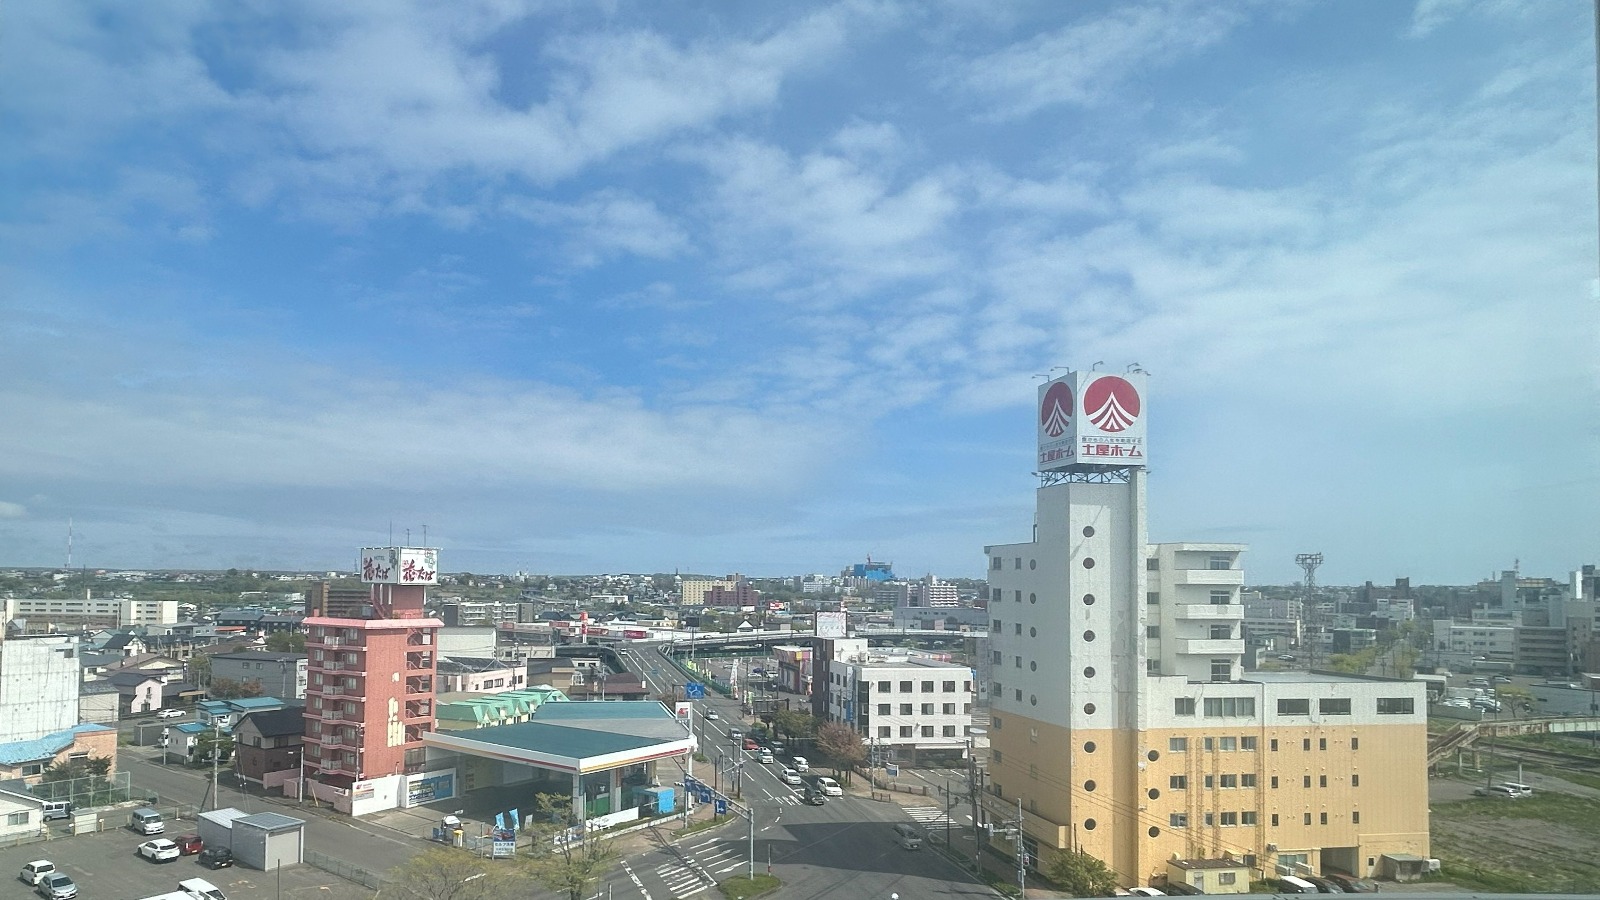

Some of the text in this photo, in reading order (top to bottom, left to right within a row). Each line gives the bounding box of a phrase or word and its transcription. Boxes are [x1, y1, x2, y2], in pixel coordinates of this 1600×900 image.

[1040, 445, 1075, 463] 土屋ホーム
[1082, 444, 1142, 457] 土屋ホーム
[363, 557, 391, 581] 花たば
[402, 559, 435, 582] 花たば
